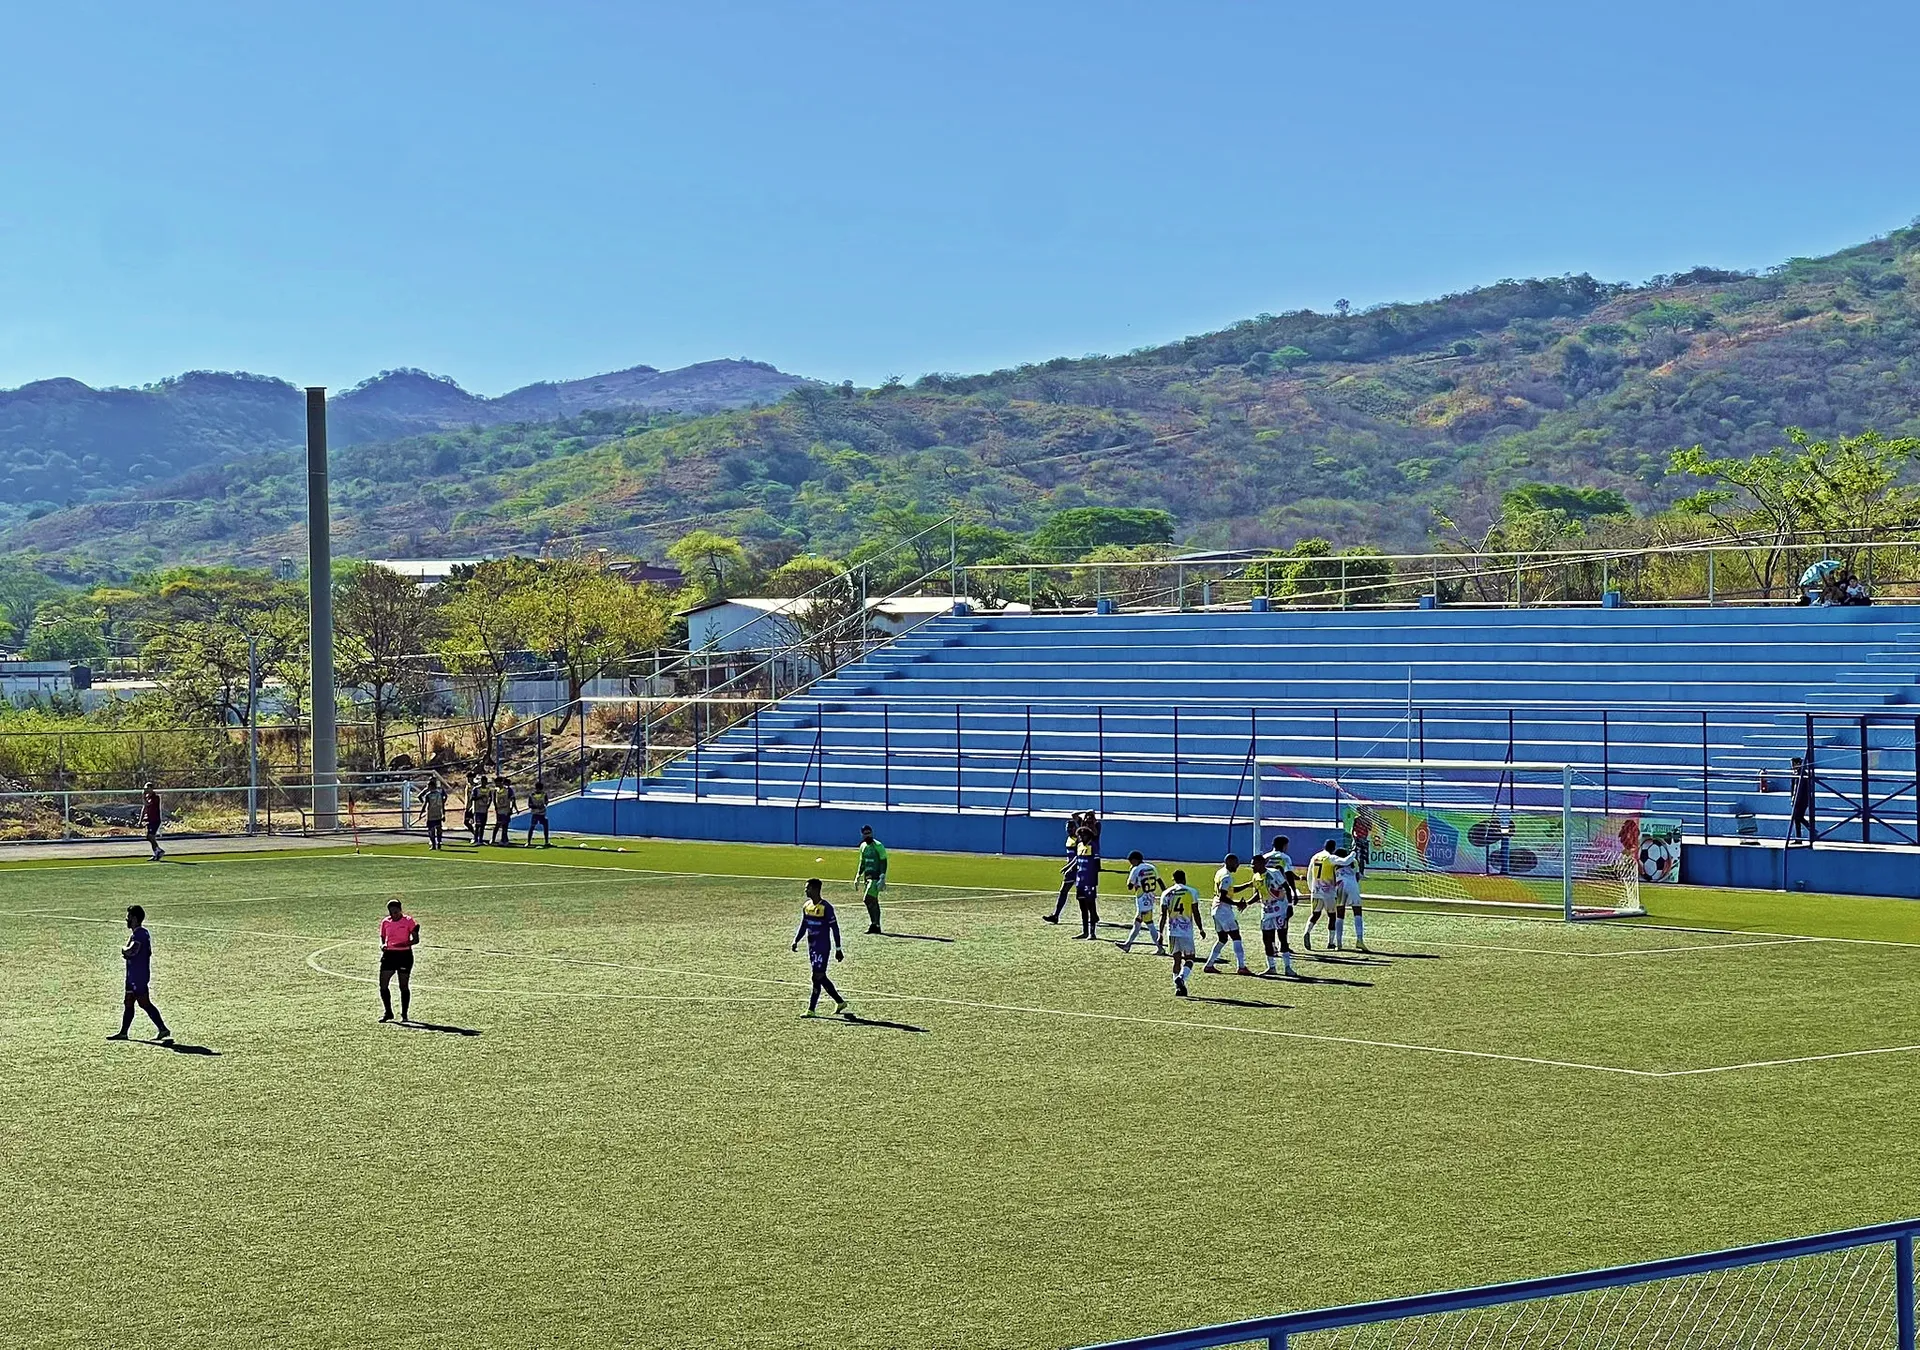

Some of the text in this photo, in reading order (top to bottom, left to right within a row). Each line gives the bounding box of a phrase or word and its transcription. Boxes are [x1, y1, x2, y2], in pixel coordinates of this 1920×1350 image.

[1366, 846, 1406, 863] orteño
[1314, 862, 1323, 879] 7
[1140, 876, 1157, 893] 63
[1173, 896, 1185, 914] 4
